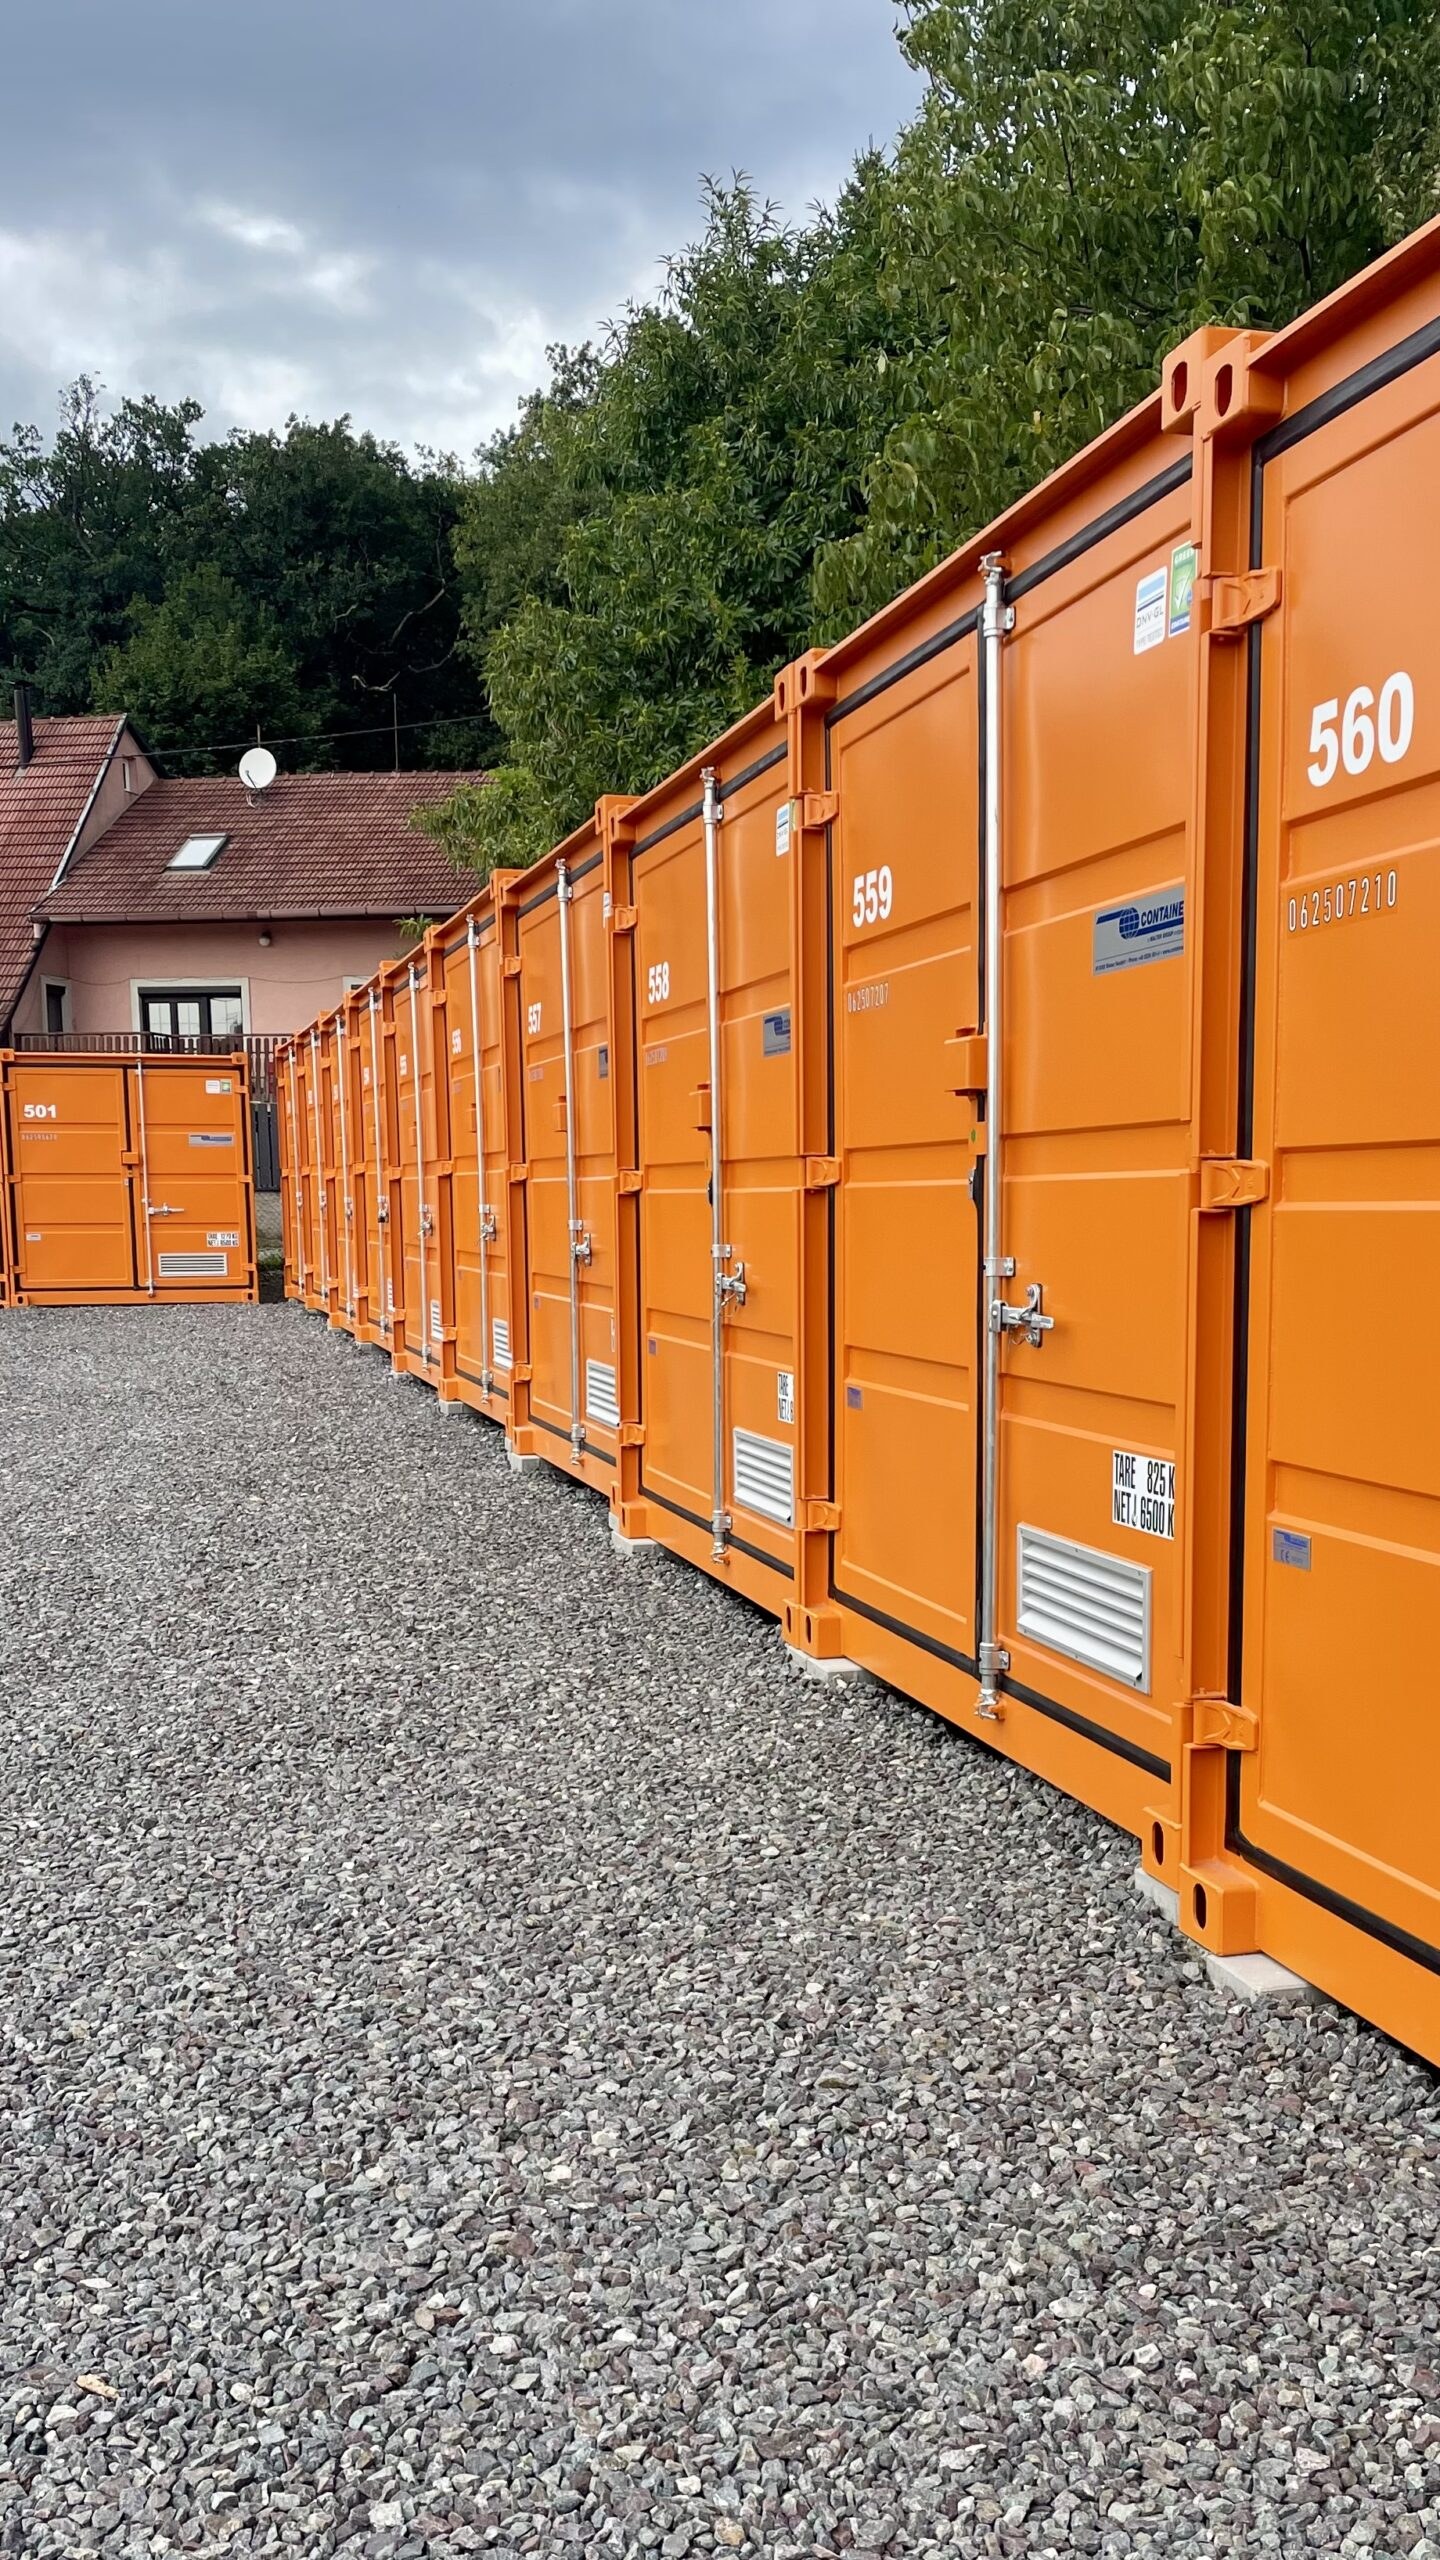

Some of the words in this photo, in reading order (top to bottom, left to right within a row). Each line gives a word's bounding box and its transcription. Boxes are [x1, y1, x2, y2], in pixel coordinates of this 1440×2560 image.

[1307, 671, 1415, 788] 560
[852, 865, 893, 928] 559
[1288, 869, 1398, 933] 062507210
[648, 961, 670, 1005] 558
[527, 1002, 542, 1034] 557
[23, 1104, 57, 1118] 501
[1114, 1453, 1137, 1489] TARE
[1147, 1460, 1166, 1497] 825
[1113, 1489, 1132, 1525] NET
[1140, 1496, 1166, 1535] 6500
